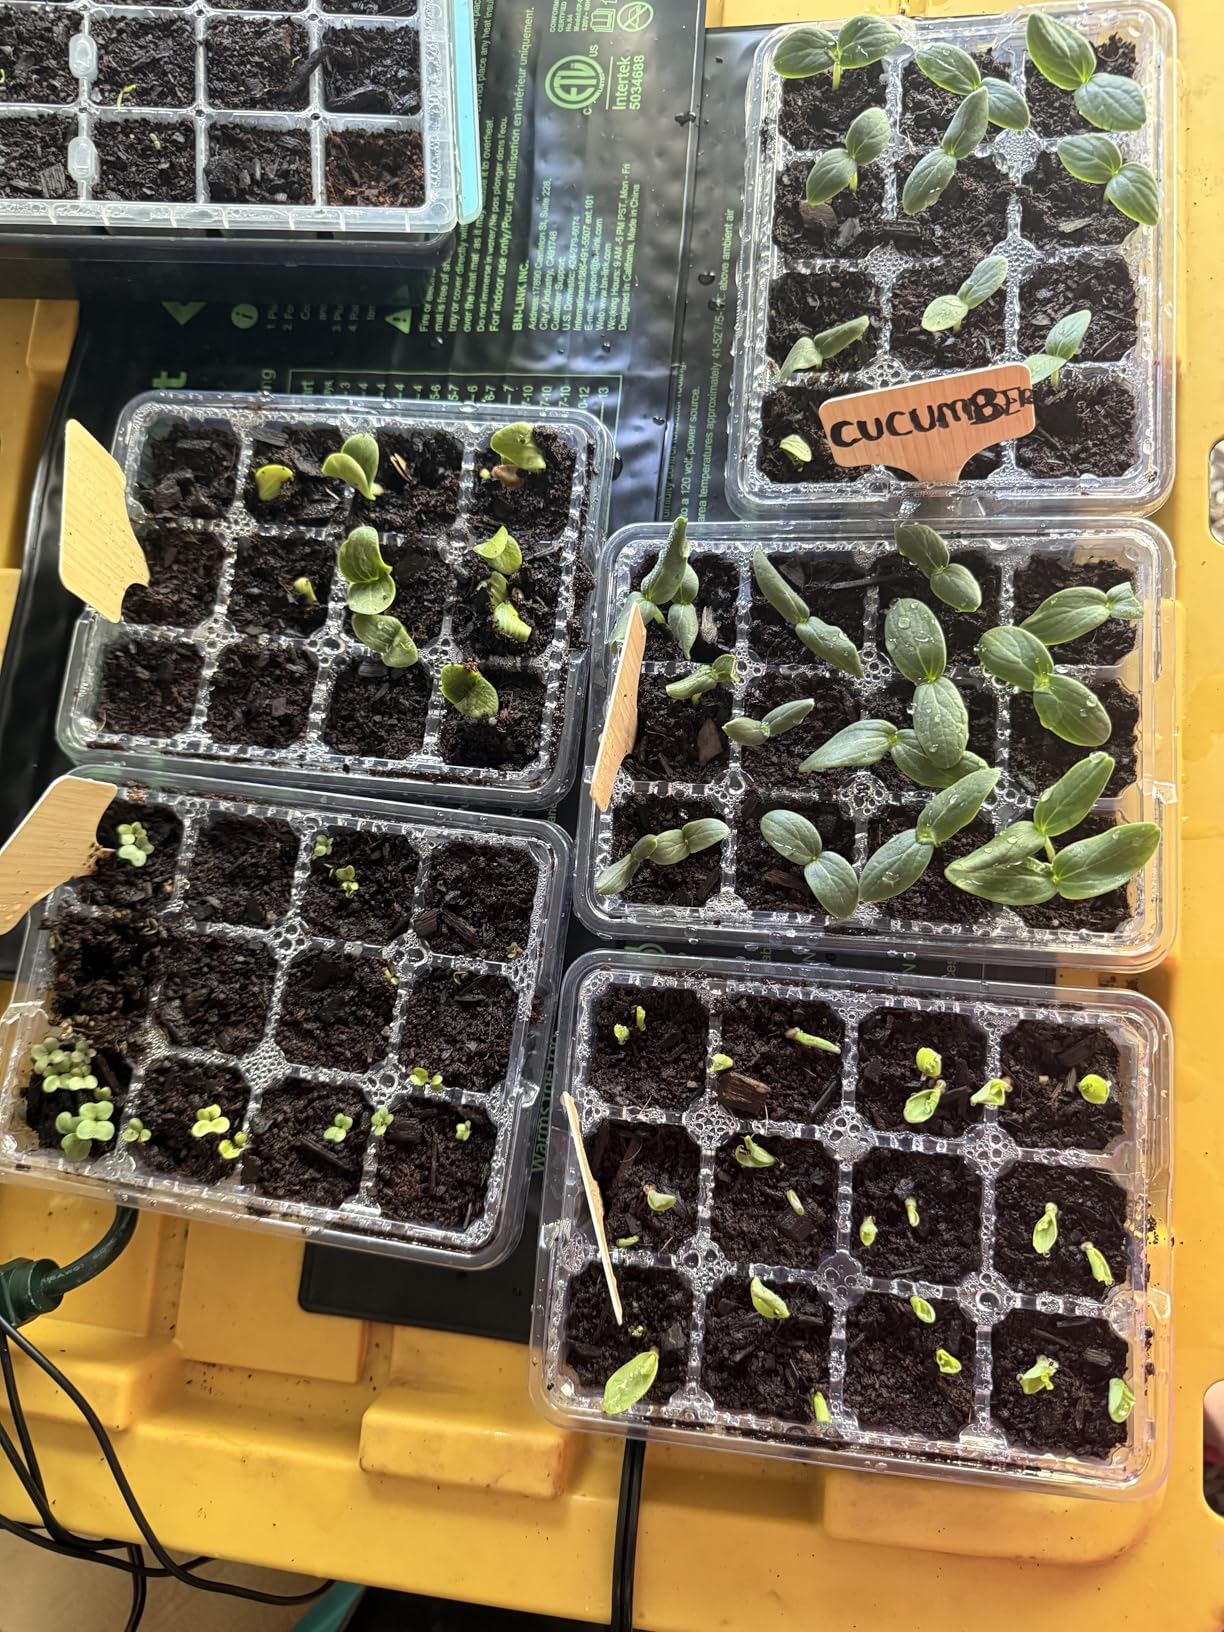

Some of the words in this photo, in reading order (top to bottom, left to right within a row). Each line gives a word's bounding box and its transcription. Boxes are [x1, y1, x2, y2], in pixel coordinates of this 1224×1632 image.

[481, 20, 492, 38] heat
[520, 7, 535, 65] uniquement.
[480, 40, 491, 55] any
[589, 44, 599, 57] US
[477, 58, 487, 81] place
[512, 68, 527, 110] intérieur
[612, 56, 631, 110] Intertek
[630, 55, 645, 110] 5034688
[514, 114, 522, 126] en
[482, 116, 495, 158] overheat.
[496, 140, 506, 160] dans
[506, 129, 521, 180] utilisation
[480, 161, 490, 170] to
[491, 163, 504, 195] plonger
[505, 182, 515, 202] une
[618, 181, 629, 198] Mon
[629, 184, 640, 208] China
[492, 196, 501, 212] pas
[540, 198, 550, 218] Suite
[725, 209, 734, 221] air
[615, 222, 625, 235] PM
[627, 218, 637, 240] Made
[473, 238, 481, 250] as
[721, 224, 733, 260] ambient
[453, 242, 468, 274] directly
[469, 254, 480, 270] mat
[497, 258, 508, 275] use
[440, 273, 450, 283] of
[519, 260, 529, 282] INC.
[719, 262, 730, 290] above
[452, 276, 462, 300] cover
[466, 272, 477, 294] heat
[480, 265, 492, 302] immerse
[610, 269, 621, 295] Hours:
[437, 285, 448, 302] free
[464, 295, 475, 310] the
[491, 277, 505, 311] indoor
[424, 302, 432, 312] or
[436, 304, 446, 312] is
[450, 302, 459, 312] or
[478, 303, 488, 317] not
[512, 283, 527, 331] BN-LINK
[607, 297, 620, 330] Working
[618, 293, 631, 330] Designed
[419, 314, 430, 332] Fire
[435, 314, 444, 332] mat
[448, 314, 460, 332] tray
[464, 312, 473, 332] over
[476, 319, 486, 332] Do
[489, 314, 500, 331] For
[540, 313, 550, 330] City
[562, 312, 571, 330] U.S.
[689, 386, 700, 422] source.
[706, 363, 721, 429] approximately
[687, 424, 697, 454] power
[684, 458, 694, 474] volt
[698, 432, 713, 497] temperatures
[681, 477, 691, 494] 120
[698, 501, 707, 522] area
